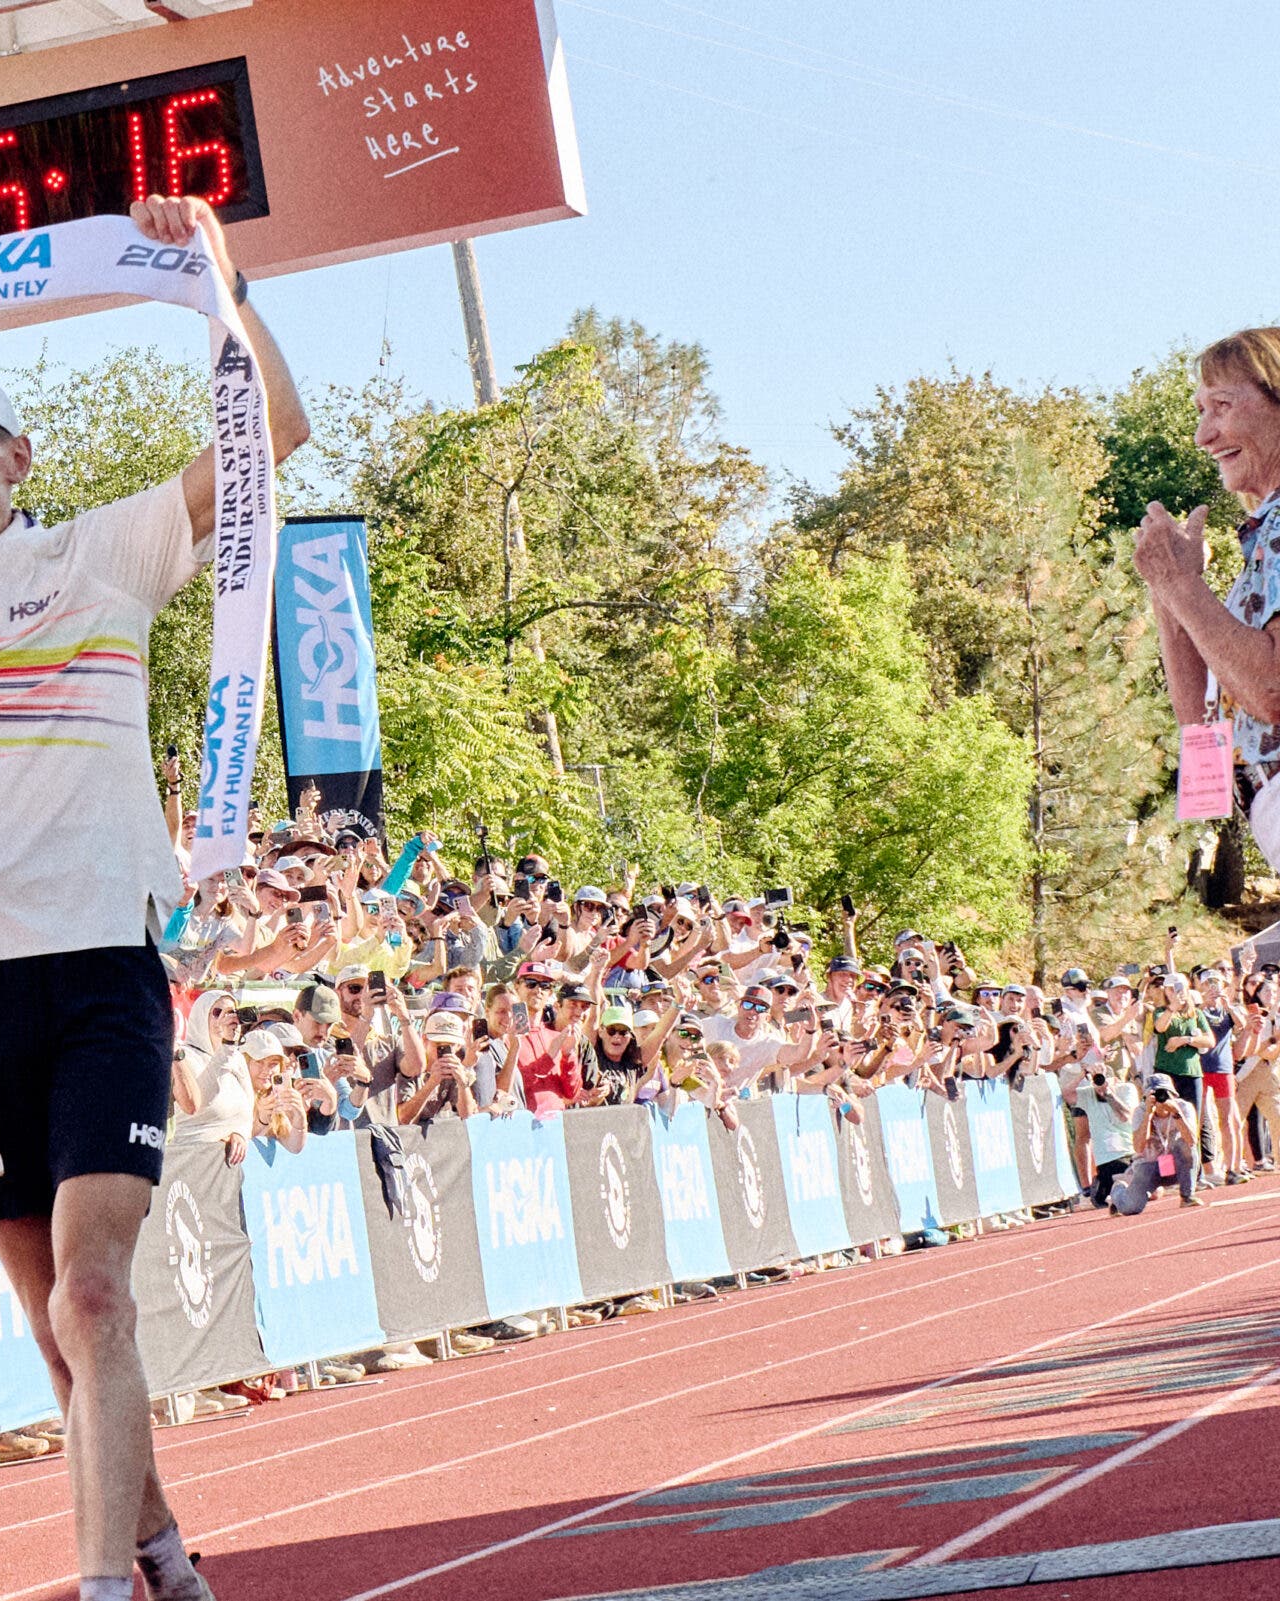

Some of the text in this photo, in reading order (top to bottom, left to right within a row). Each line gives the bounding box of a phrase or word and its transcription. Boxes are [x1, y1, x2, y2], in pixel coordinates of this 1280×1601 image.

[13, 278, 50, 300] FLY
[215, 384, 238, 598] WESTERN STATES
[230, 388, 255, 592] ENDURANCE RUN
[257, 450, 267, 491] MILES
[259, 493, 268, 515] 100
[291, 532, 363, 740] HOKA
[222, 673, 256, 836] FLY HUMAN FLY
[262, 1181, 360, 1289] HOKA
[486, 1157, 565, 1249] HOKA
